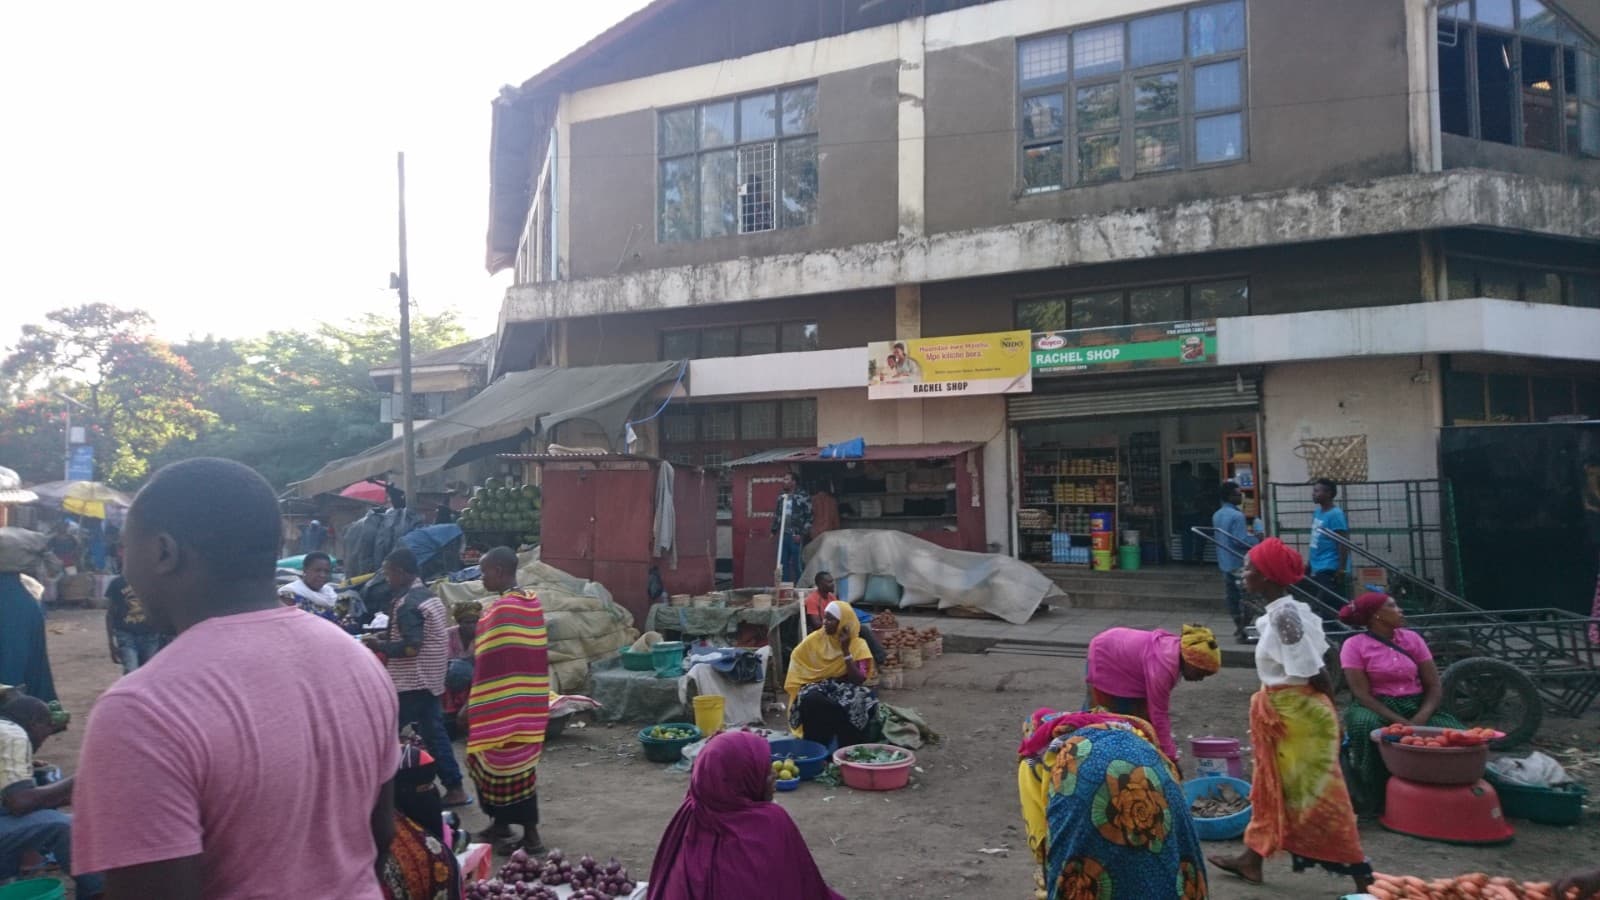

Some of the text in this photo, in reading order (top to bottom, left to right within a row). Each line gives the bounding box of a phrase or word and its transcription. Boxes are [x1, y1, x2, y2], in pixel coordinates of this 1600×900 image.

[1036, 348, 1120, 364] RACHEL SHOP
[913, 382, 968, 393] RACHEL SHOP
